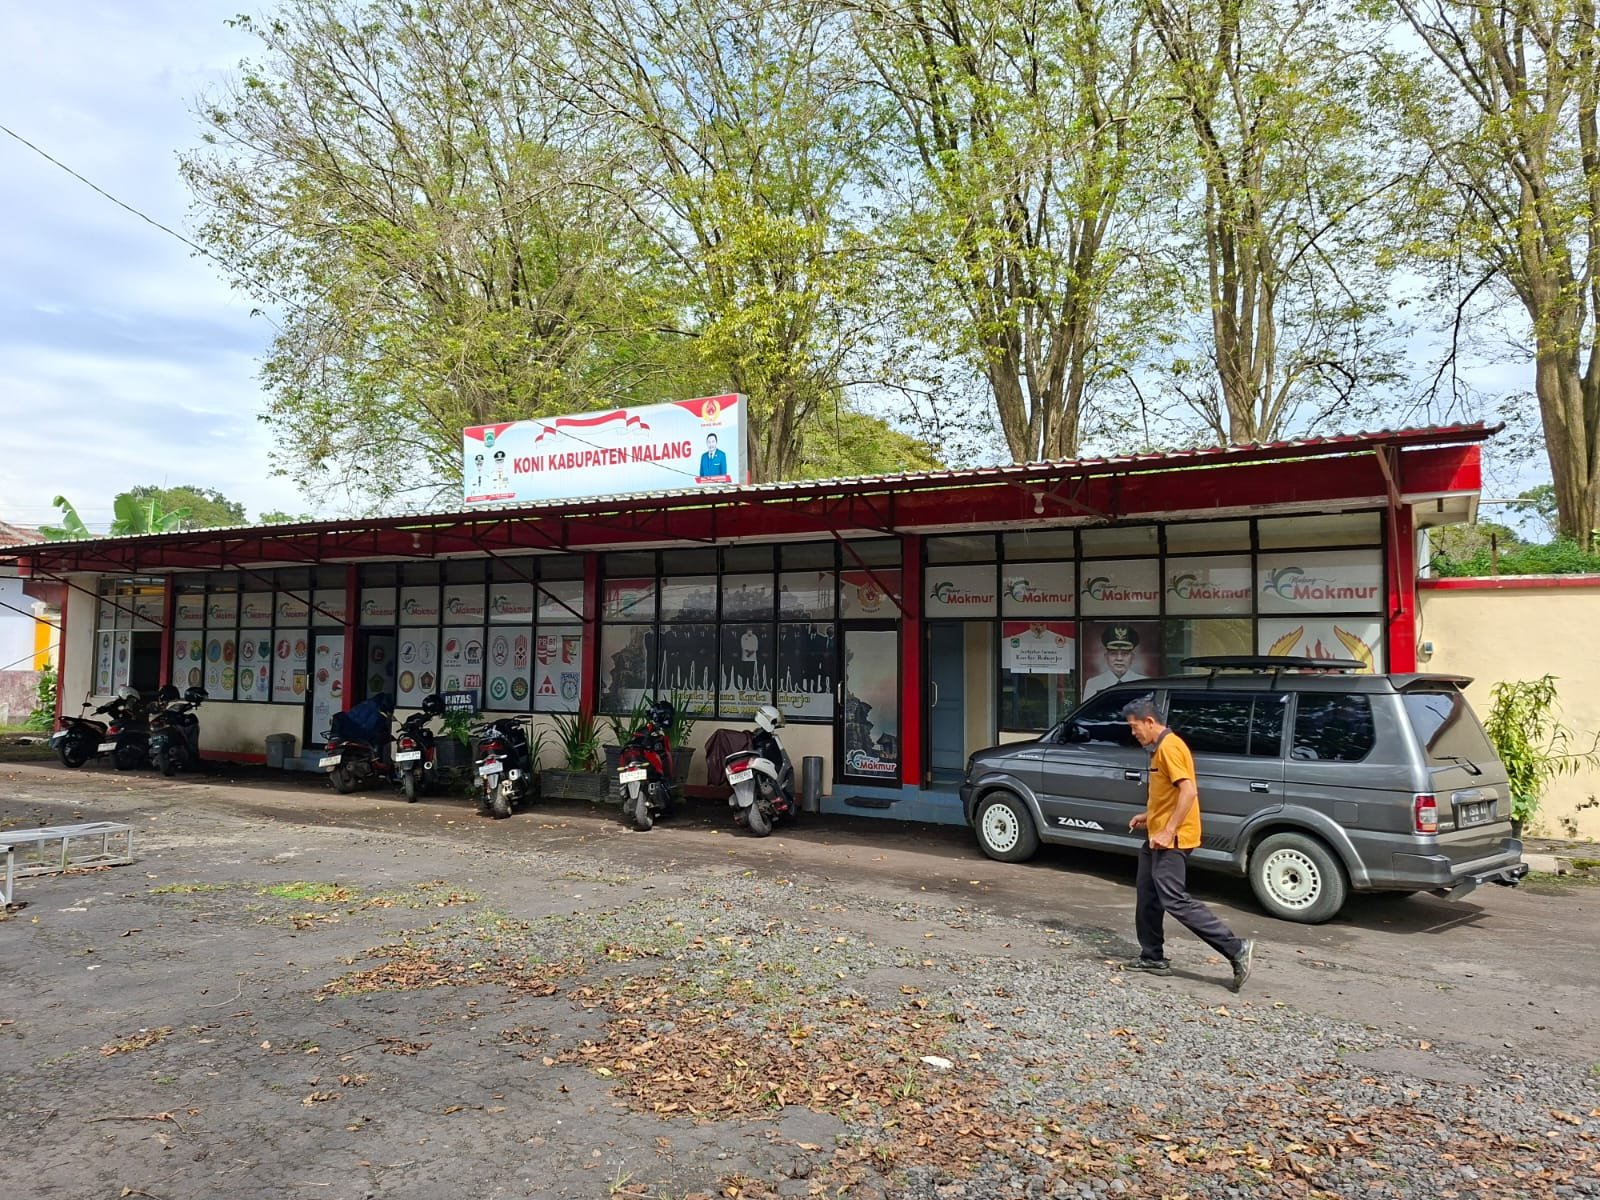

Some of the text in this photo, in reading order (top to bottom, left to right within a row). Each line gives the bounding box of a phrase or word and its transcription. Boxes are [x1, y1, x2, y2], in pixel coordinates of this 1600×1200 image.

[513, 440, 692, 474] KONI KABUPATEN MALANG
[947, 592, 994, 604] Makmur
[1022, 591, 1073, 603] Makmur
[1101, 590, 1159, 601] Makmur
[1188, 586, 1250, 600] Makmur
[1293, 584, 1378, 600] Makmur
[860, 761, 897, 772] Makmur
[1057, 816, 1105, 831] ZALVA
